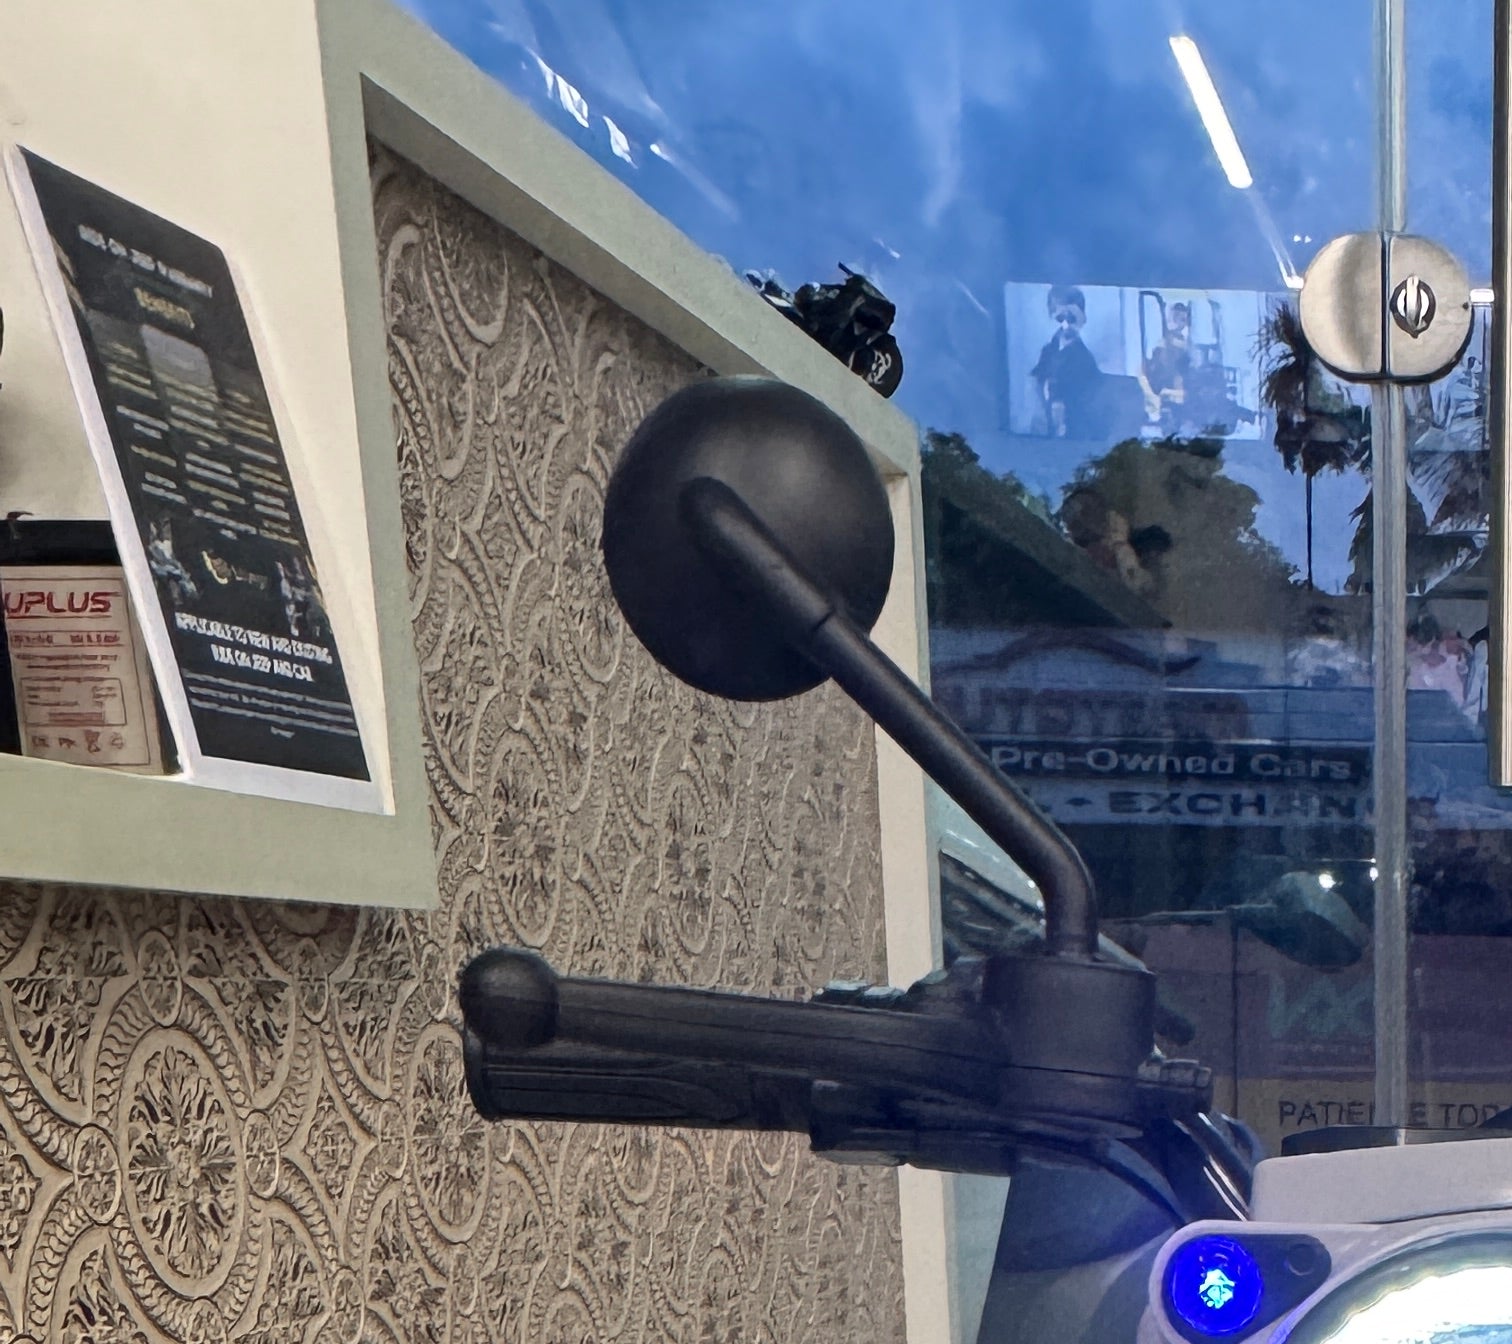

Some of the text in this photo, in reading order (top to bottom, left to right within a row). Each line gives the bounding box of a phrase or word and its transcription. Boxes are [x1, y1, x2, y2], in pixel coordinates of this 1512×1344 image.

[992, 746, 1351, 780] Pre-Owned Cars
[1108, 791, 1373, 819] EXCHAN
[1278, 1100, 1429, 1128] PATIEE
